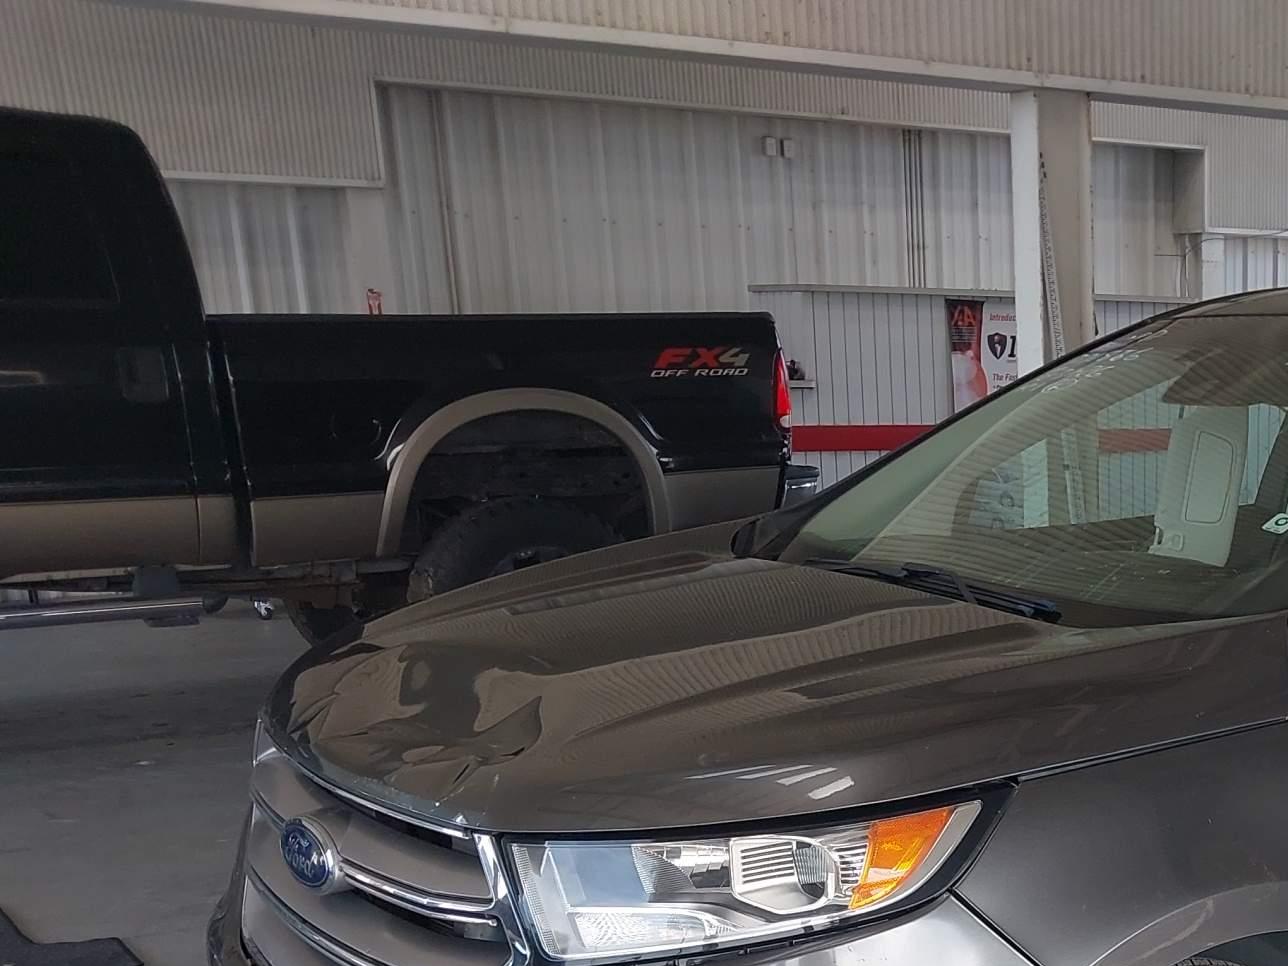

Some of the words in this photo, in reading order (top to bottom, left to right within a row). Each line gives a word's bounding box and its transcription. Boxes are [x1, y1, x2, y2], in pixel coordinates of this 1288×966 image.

[655, 347, 750, 368] FX4
[650, 369, 688, 377] OFF
[694, 368, 749, 376] ROAD
